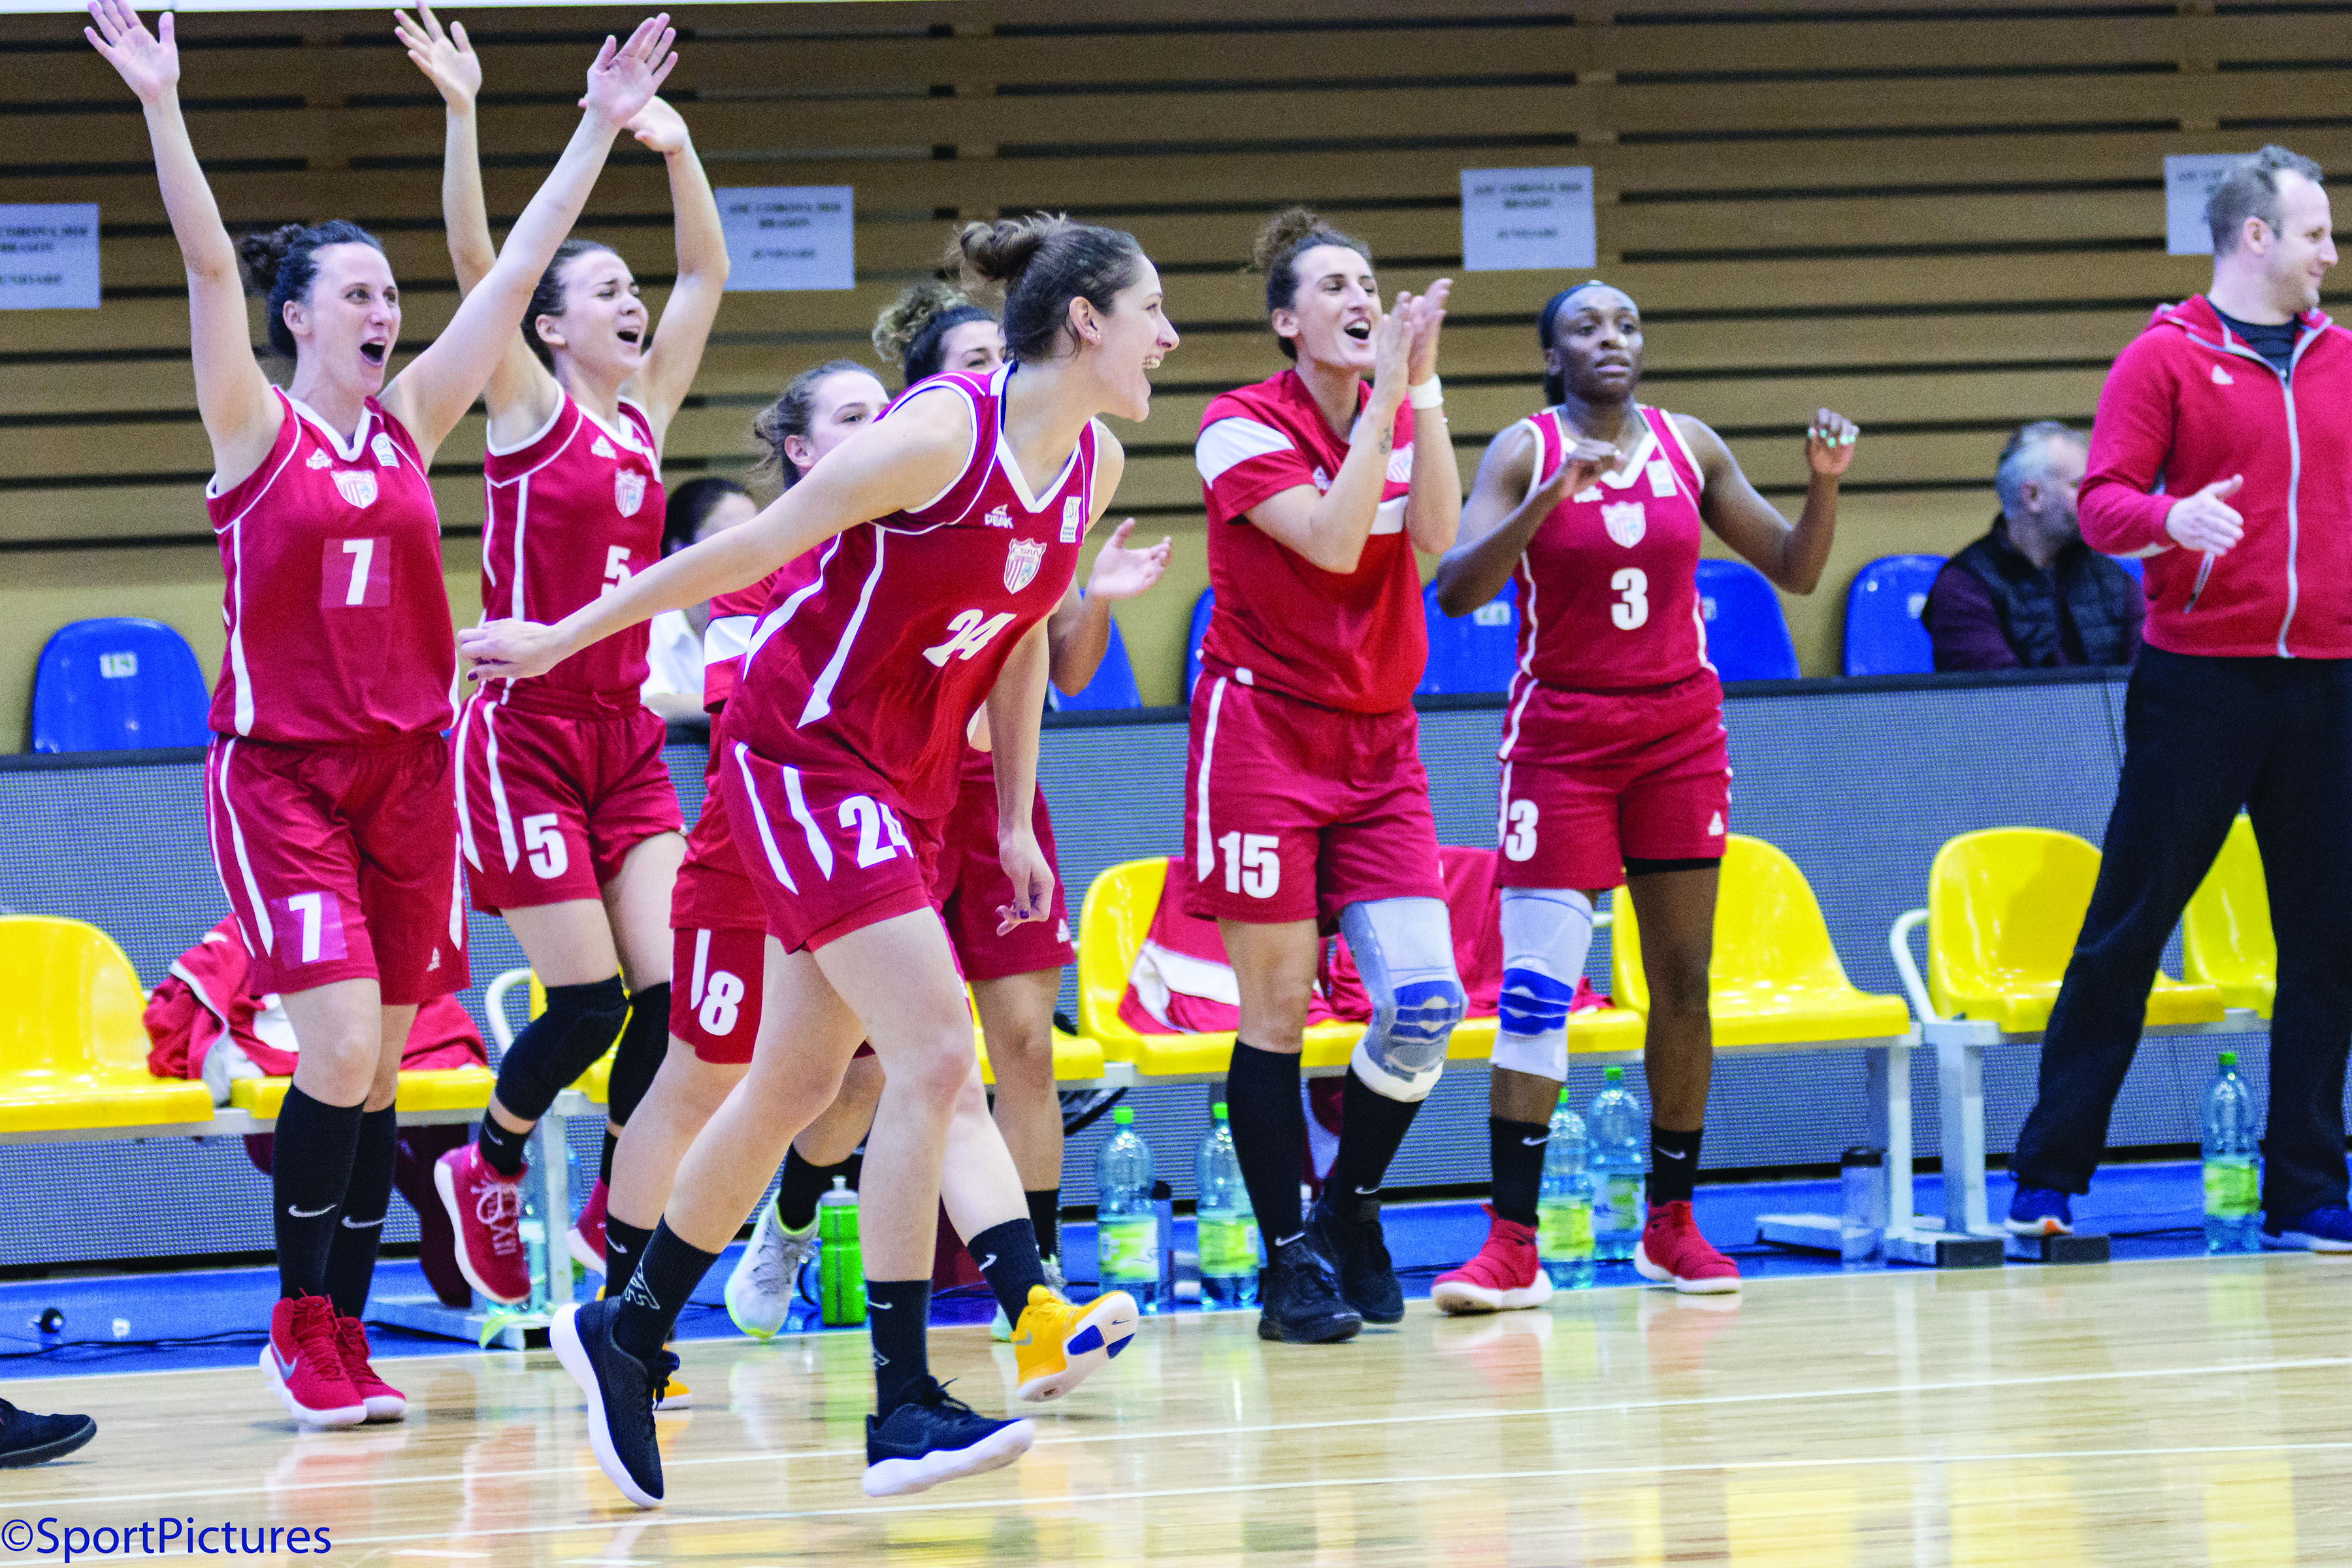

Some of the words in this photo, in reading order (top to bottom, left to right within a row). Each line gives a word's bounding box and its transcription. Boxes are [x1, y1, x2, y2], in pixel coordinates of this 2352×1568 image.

[984, 513, 1014, 529] PEAK
[342, 539, 374, 606] 7
[601, 546, 632, 598] 5
[1610, 567, 1648, 631] 3
[923, 608, 1017, 667] 24
[522, 812, 568, 879] 5
[838, 794, 913, 869] 24
[1505, 799, 1539, 862] 3
[1218, 831, 1281, 899] 15
[287, 892, 321, 963] 7
[698, 970, 745, 1036] 8
